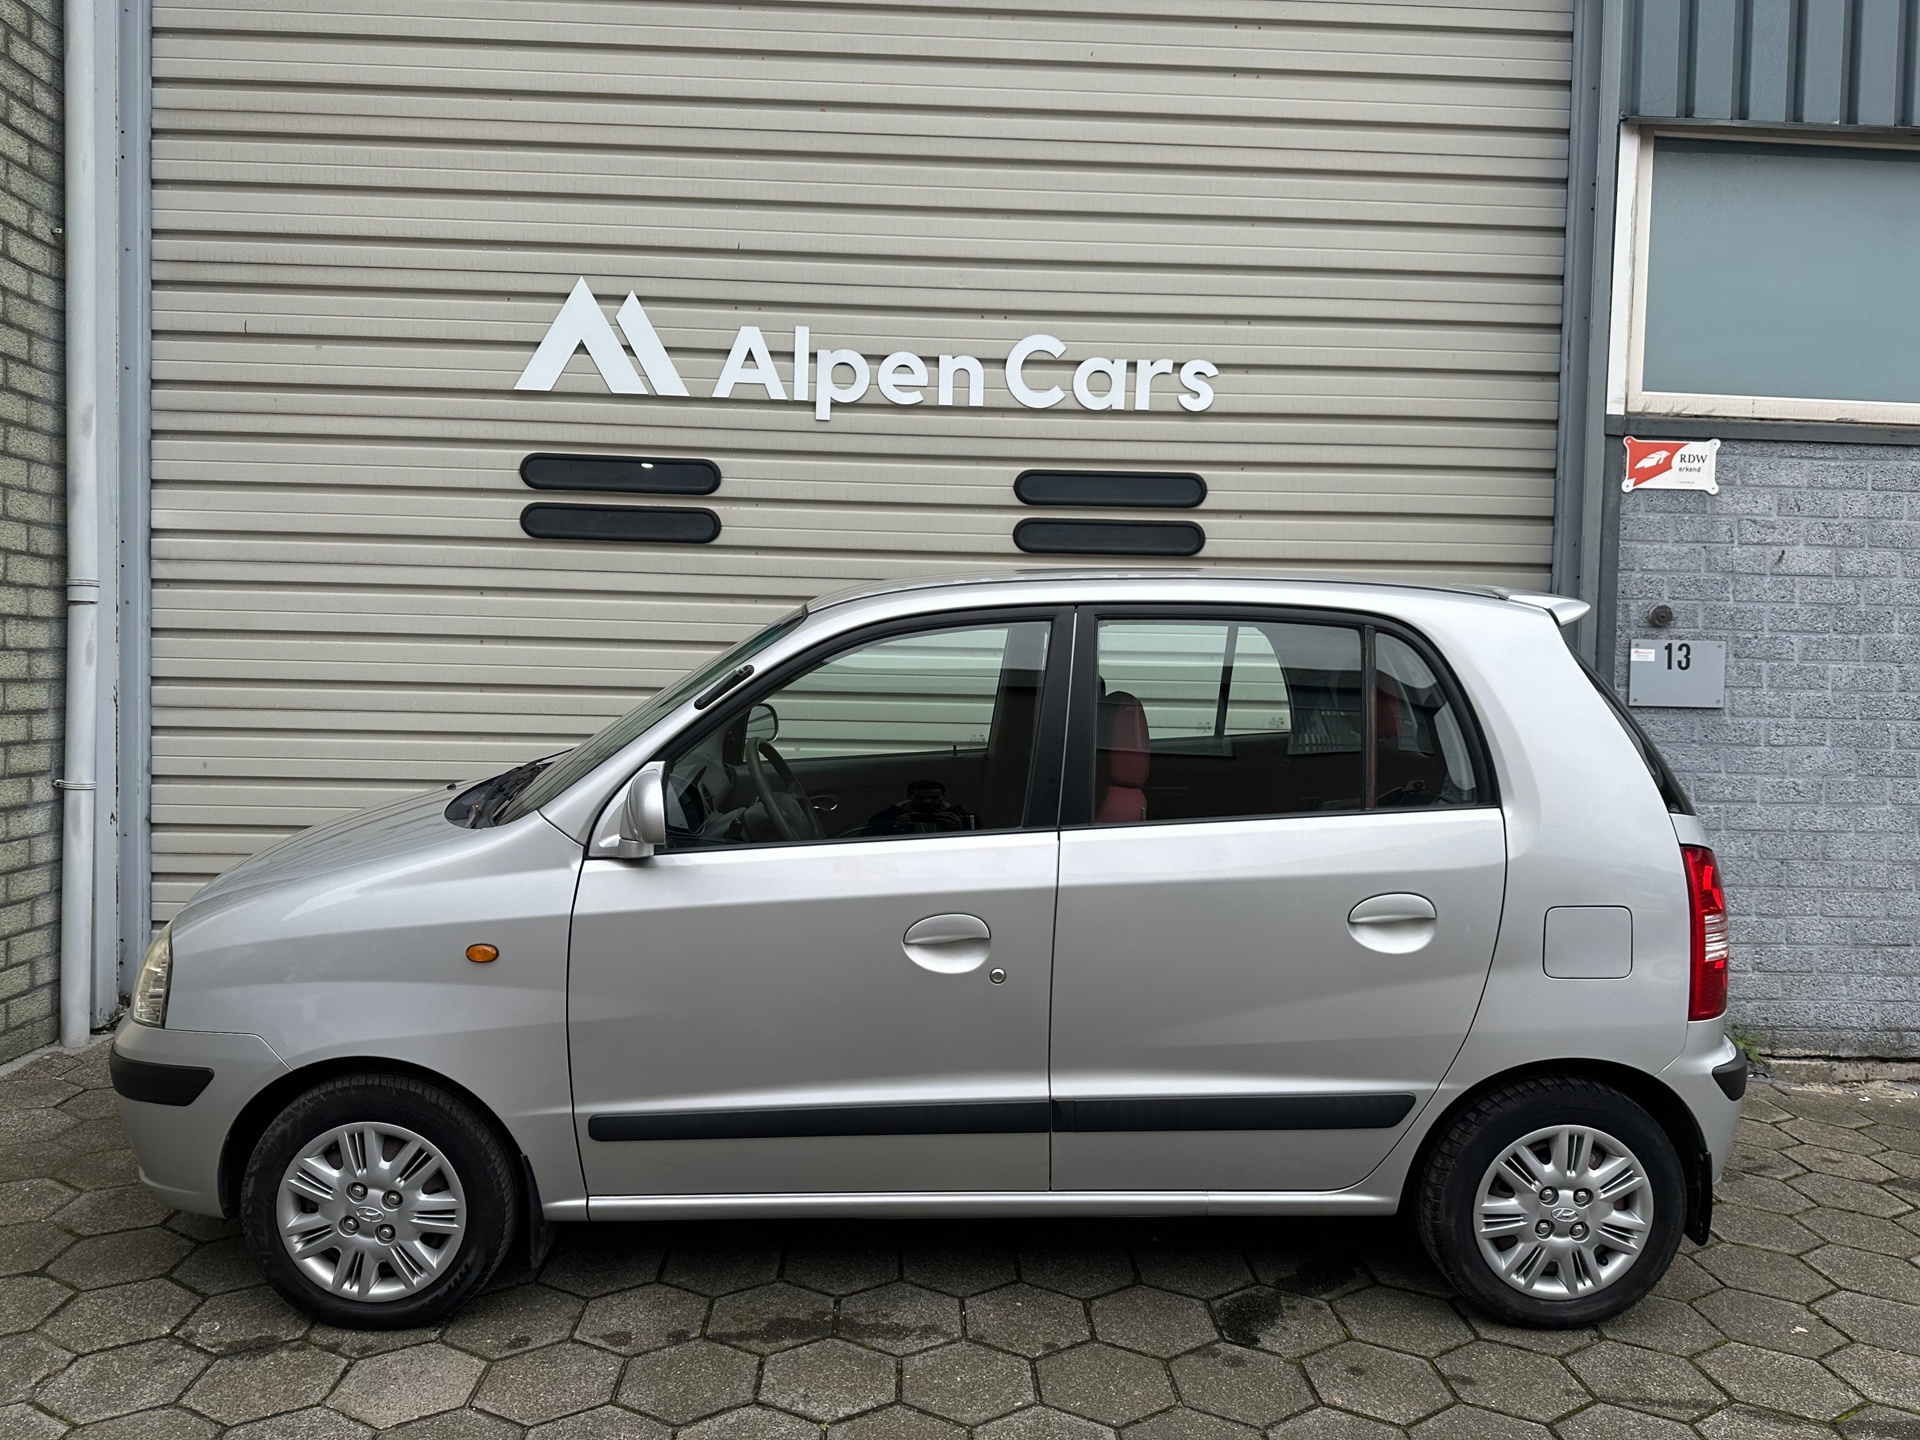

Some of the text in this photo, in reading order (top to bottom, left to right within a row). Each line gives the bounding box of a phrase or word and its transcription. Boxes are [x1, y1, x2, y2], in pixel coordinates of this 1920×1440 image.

[711, 326, 1220, 421] Alpen Cars
[1679, 453, 1708, 464] RDW
[1678, 465, 1702, 473] erkend
[1663, 643, 1691, 671] 13
